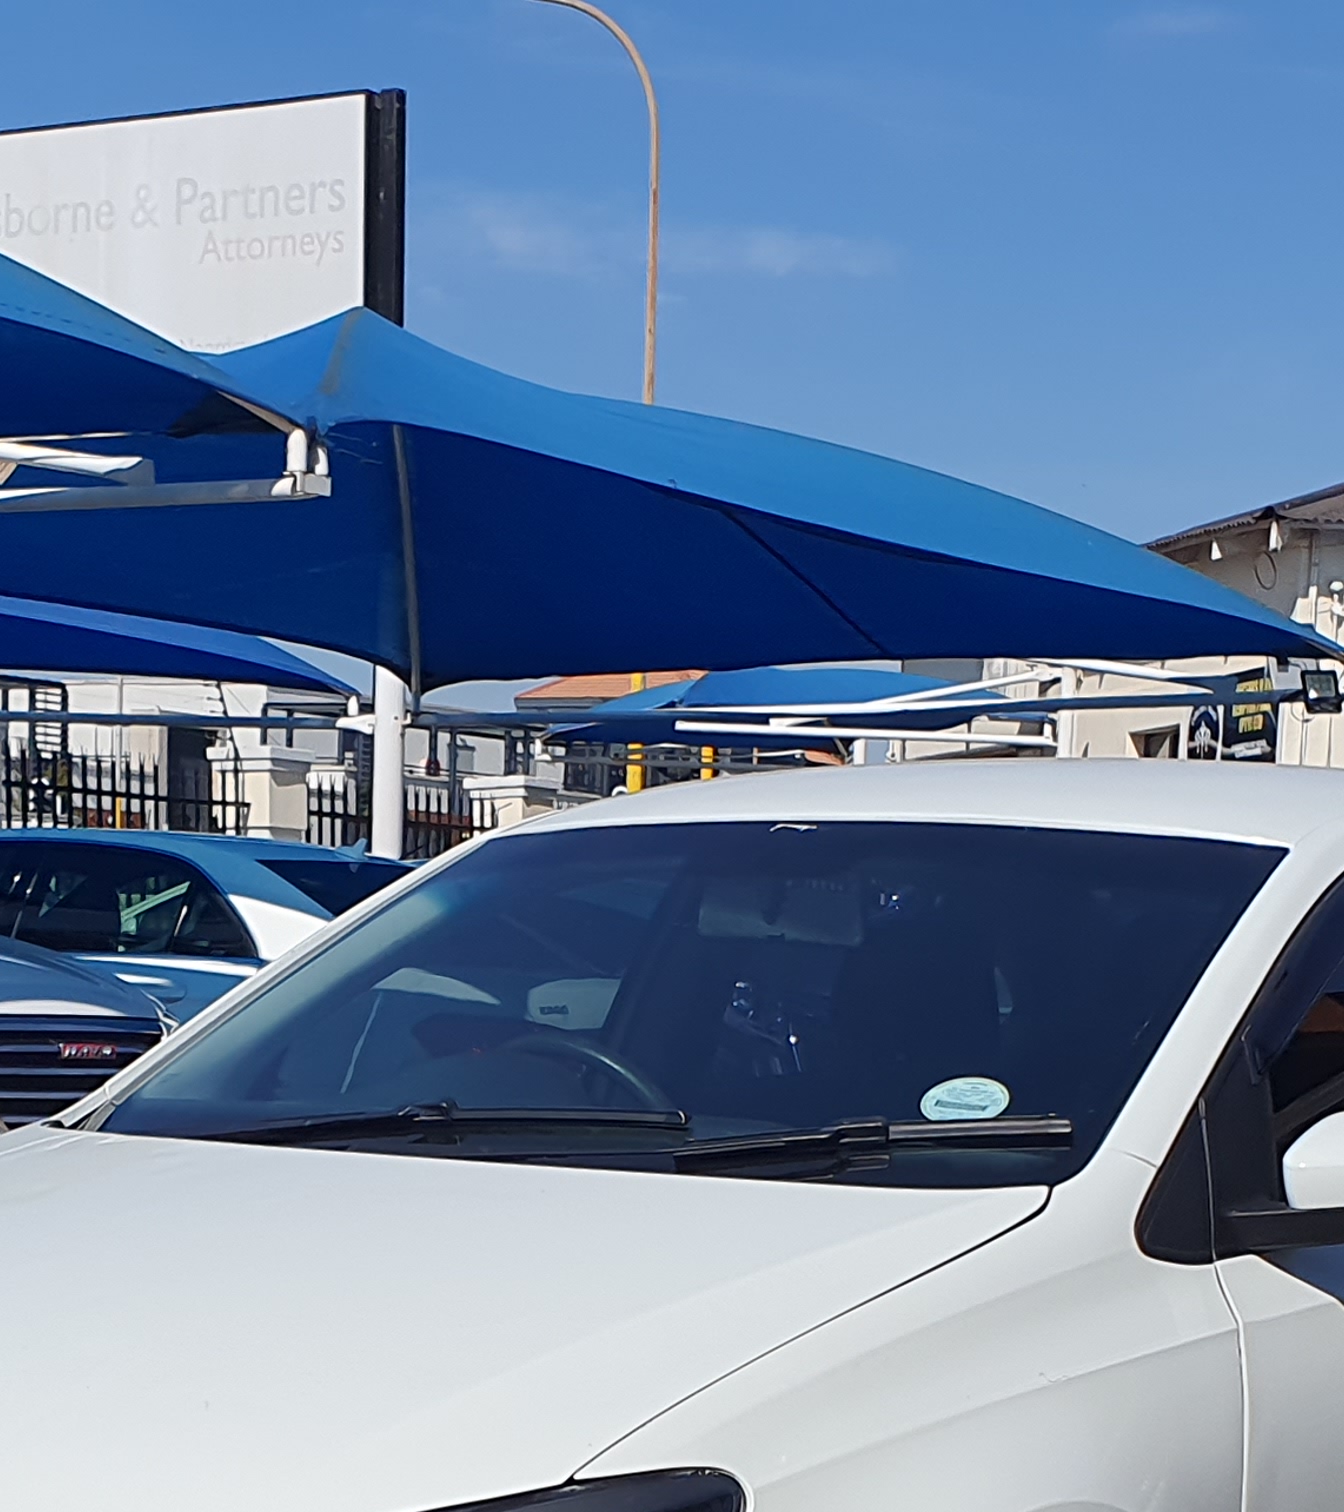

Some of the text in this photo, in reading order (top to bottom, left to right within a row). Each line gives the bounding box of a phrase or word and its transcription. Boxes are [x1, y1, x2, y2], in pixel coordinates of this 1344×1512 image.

[130, 183, 160, 228] &
[174, 177, 347, 226] Partners
[198, 229, 346, 267] Attorneys
